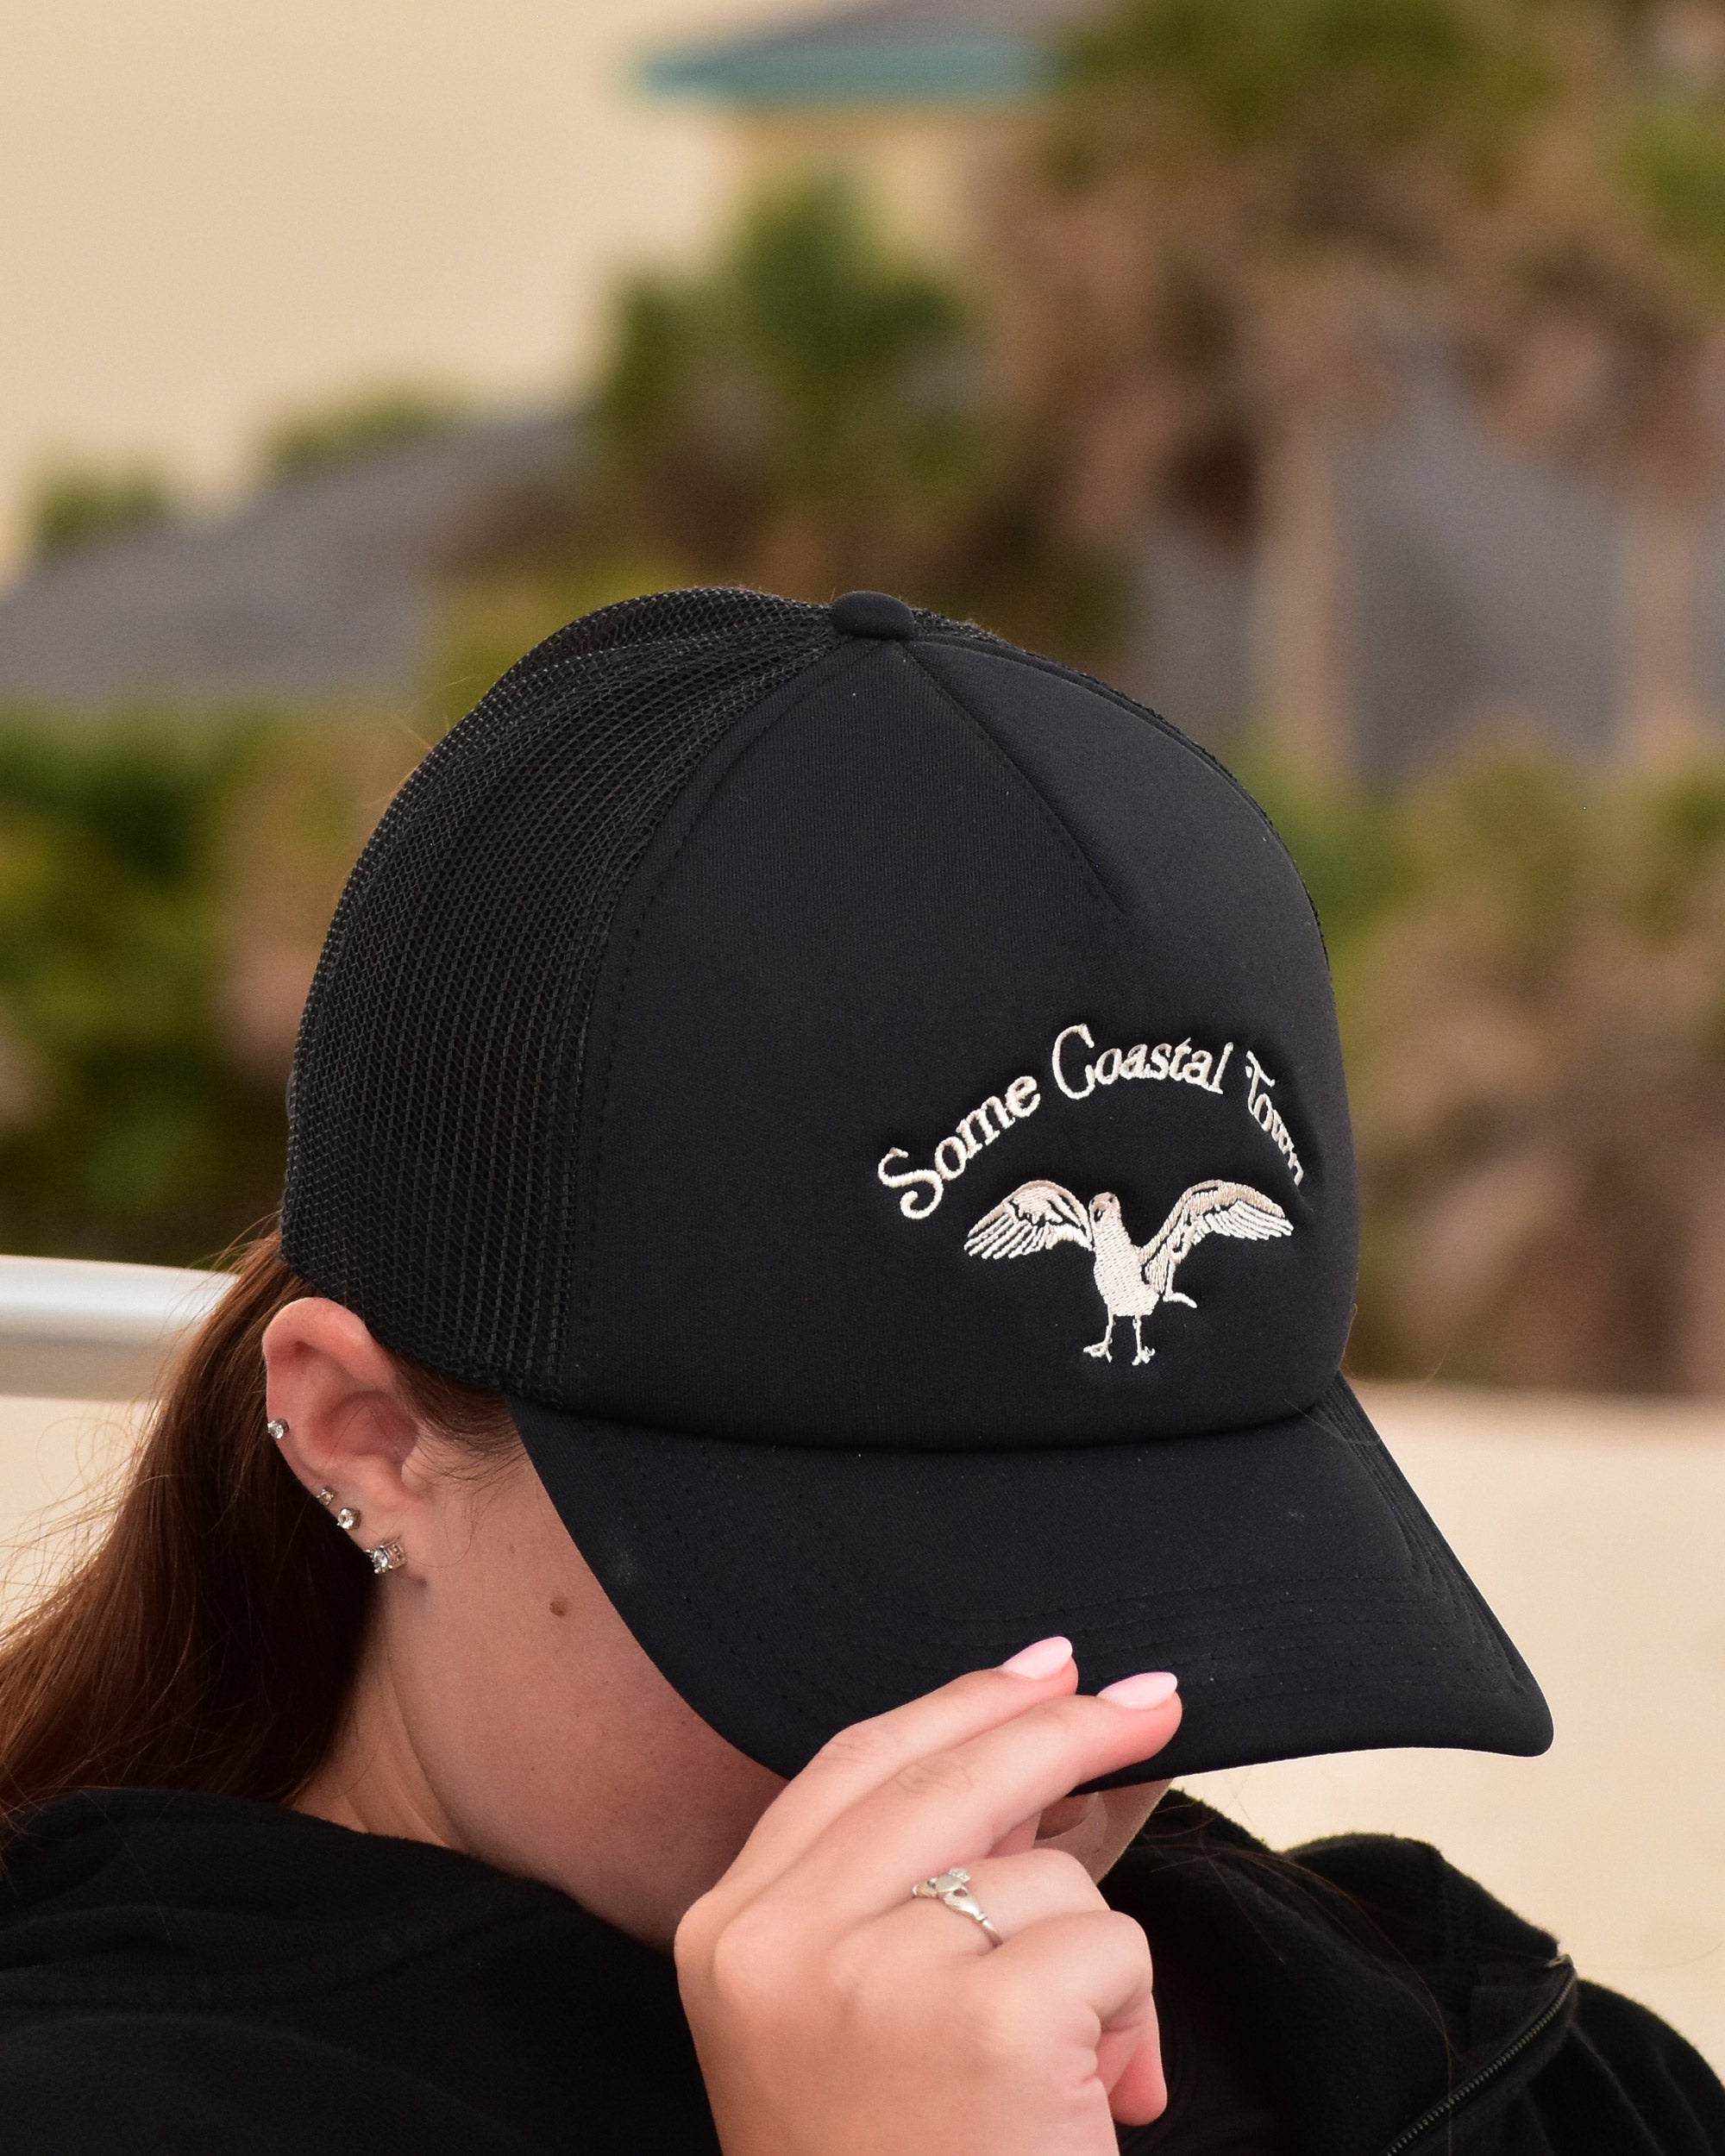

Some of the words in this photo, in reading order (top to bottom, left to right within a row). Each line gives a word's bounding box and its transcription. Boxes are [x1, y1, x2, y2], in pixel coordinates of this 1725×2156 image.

[877, 1075, 1041, 1220] Some
[1051, 1023, 1234, 1100] Coastal
[1245, 1050, 1304, 1187] Town
